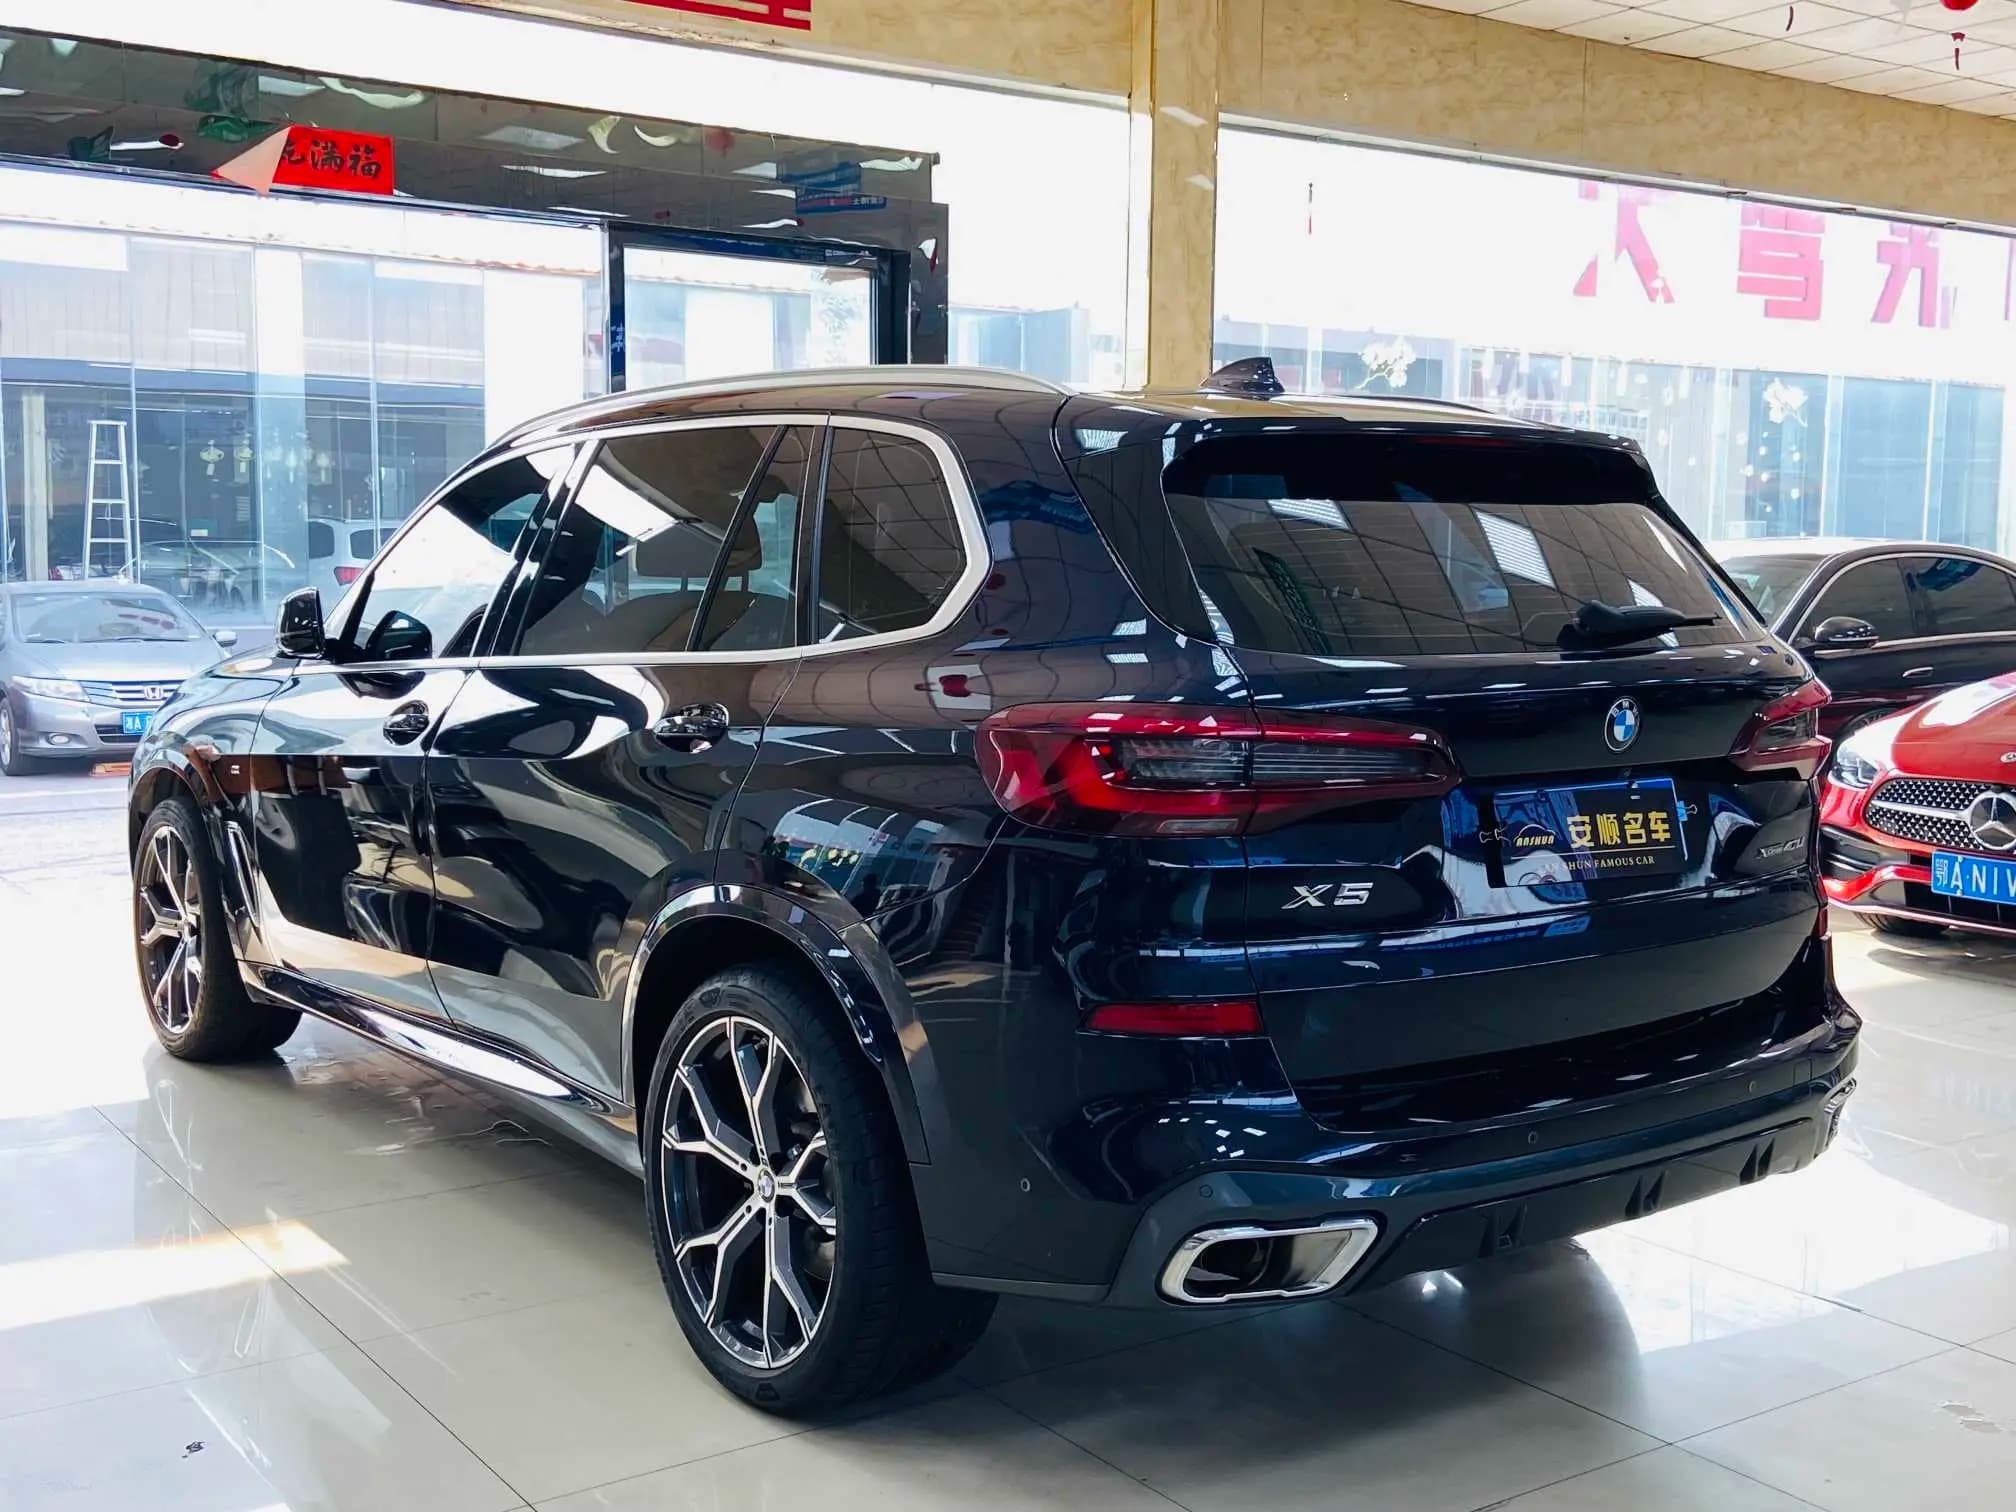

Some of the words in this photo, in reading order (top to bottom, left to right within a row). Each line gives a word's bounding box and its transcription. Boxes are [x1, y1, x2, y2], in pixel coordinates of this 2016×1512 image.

[1566, 810, 1672, 849] 安顺名车
[1594, 857, 1635, 869] FAMOUS
[1636, 855, 1655, 866] CAR
[1280, 882, 1374, 910] X5
